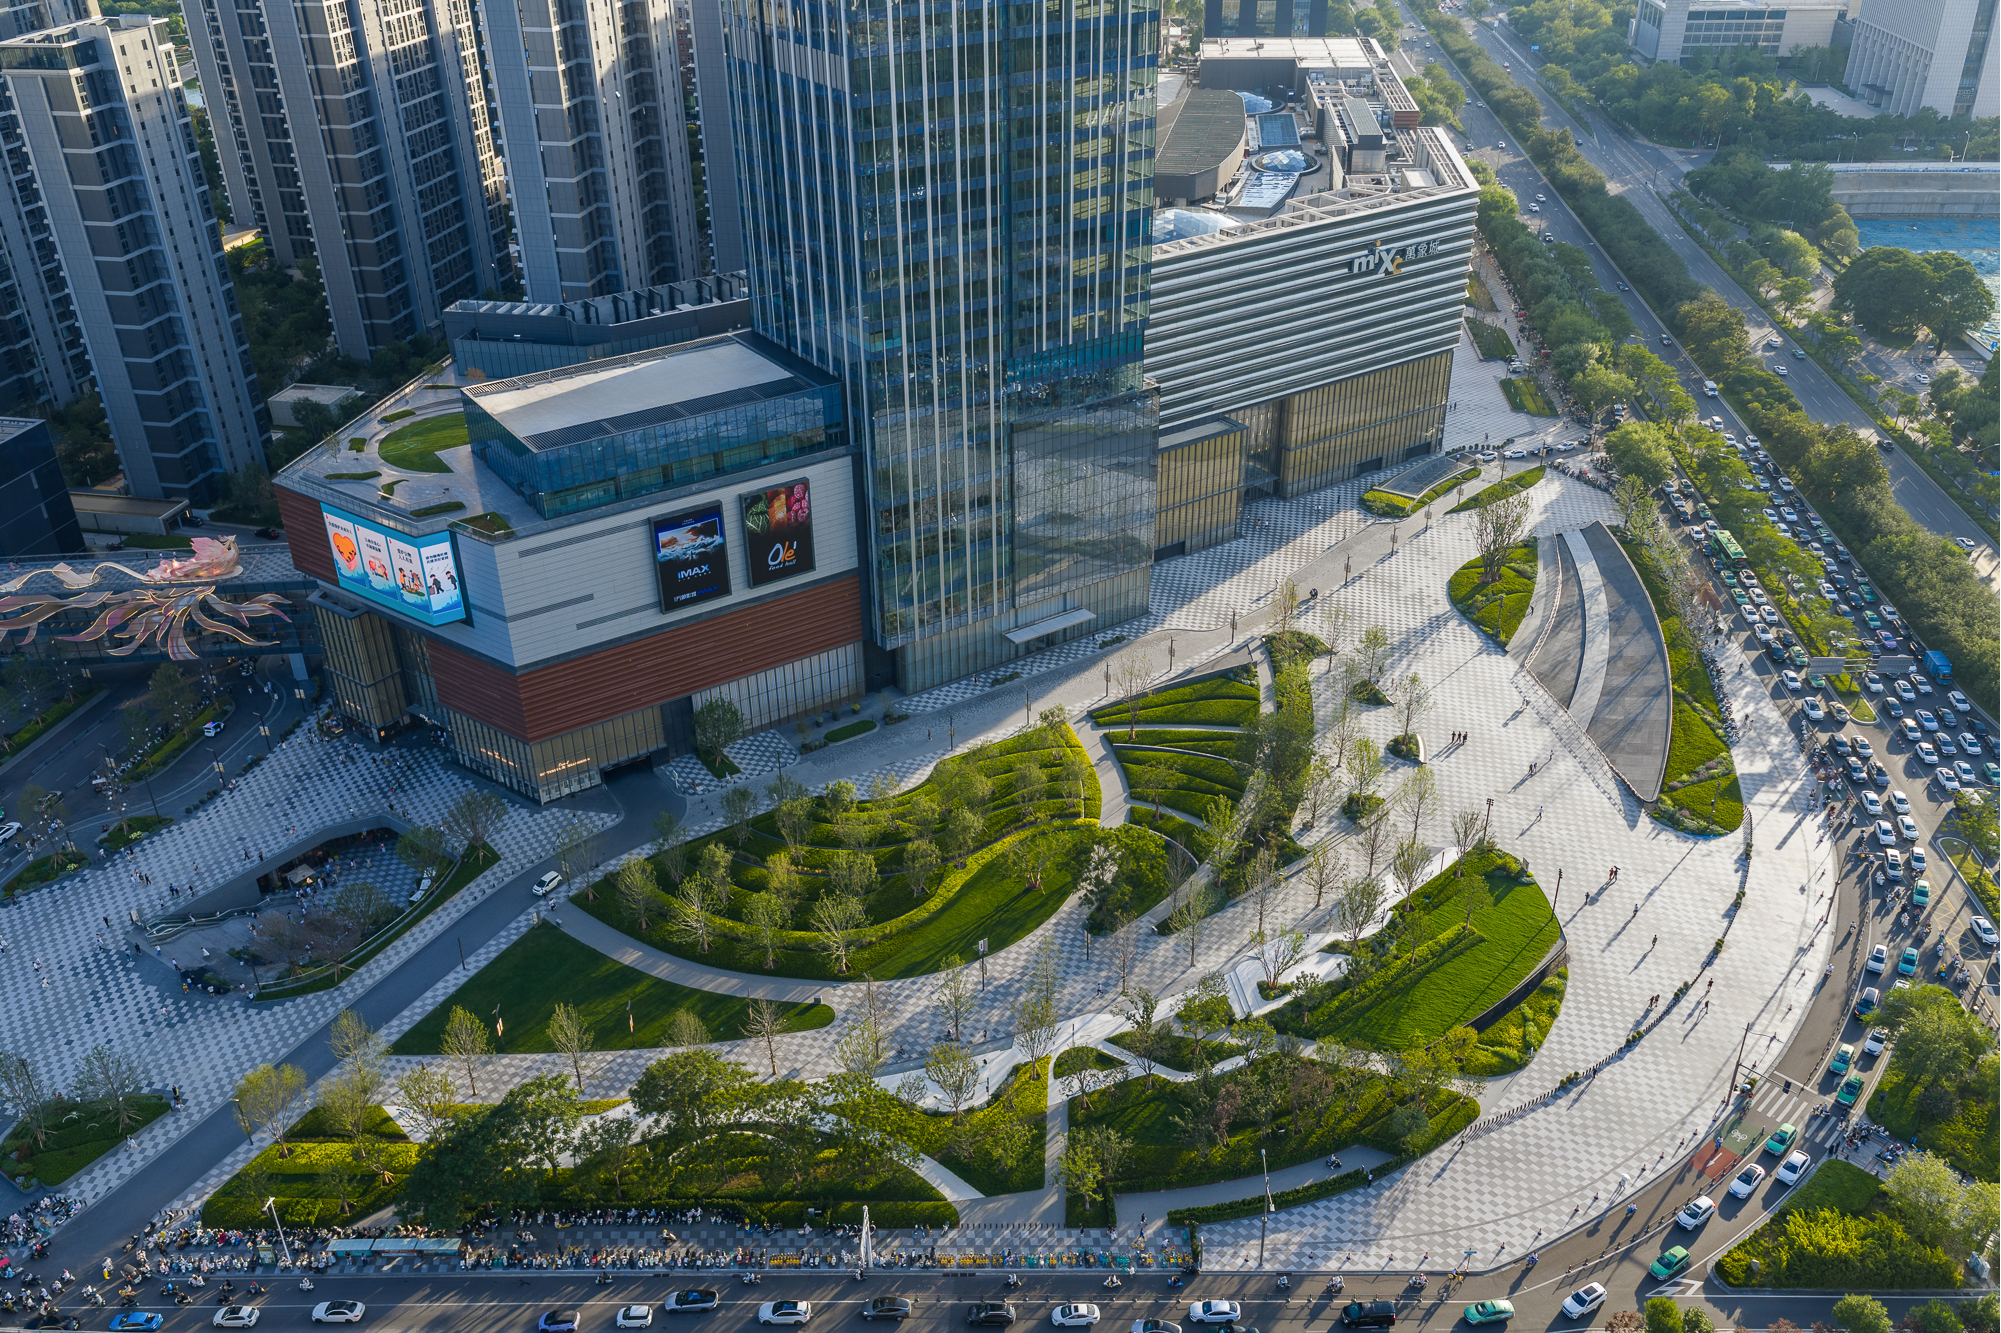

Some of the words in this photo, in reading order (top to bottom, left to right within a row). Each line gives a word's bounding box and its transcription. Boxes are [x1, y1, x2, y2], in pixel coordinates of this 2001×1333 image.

[1405, 240, 1440, 261] 萬象城
[677, 564, 710, 580] IMAX
[769, 563, 783, 571] food
[697, 585, 719, 595] IMAX
